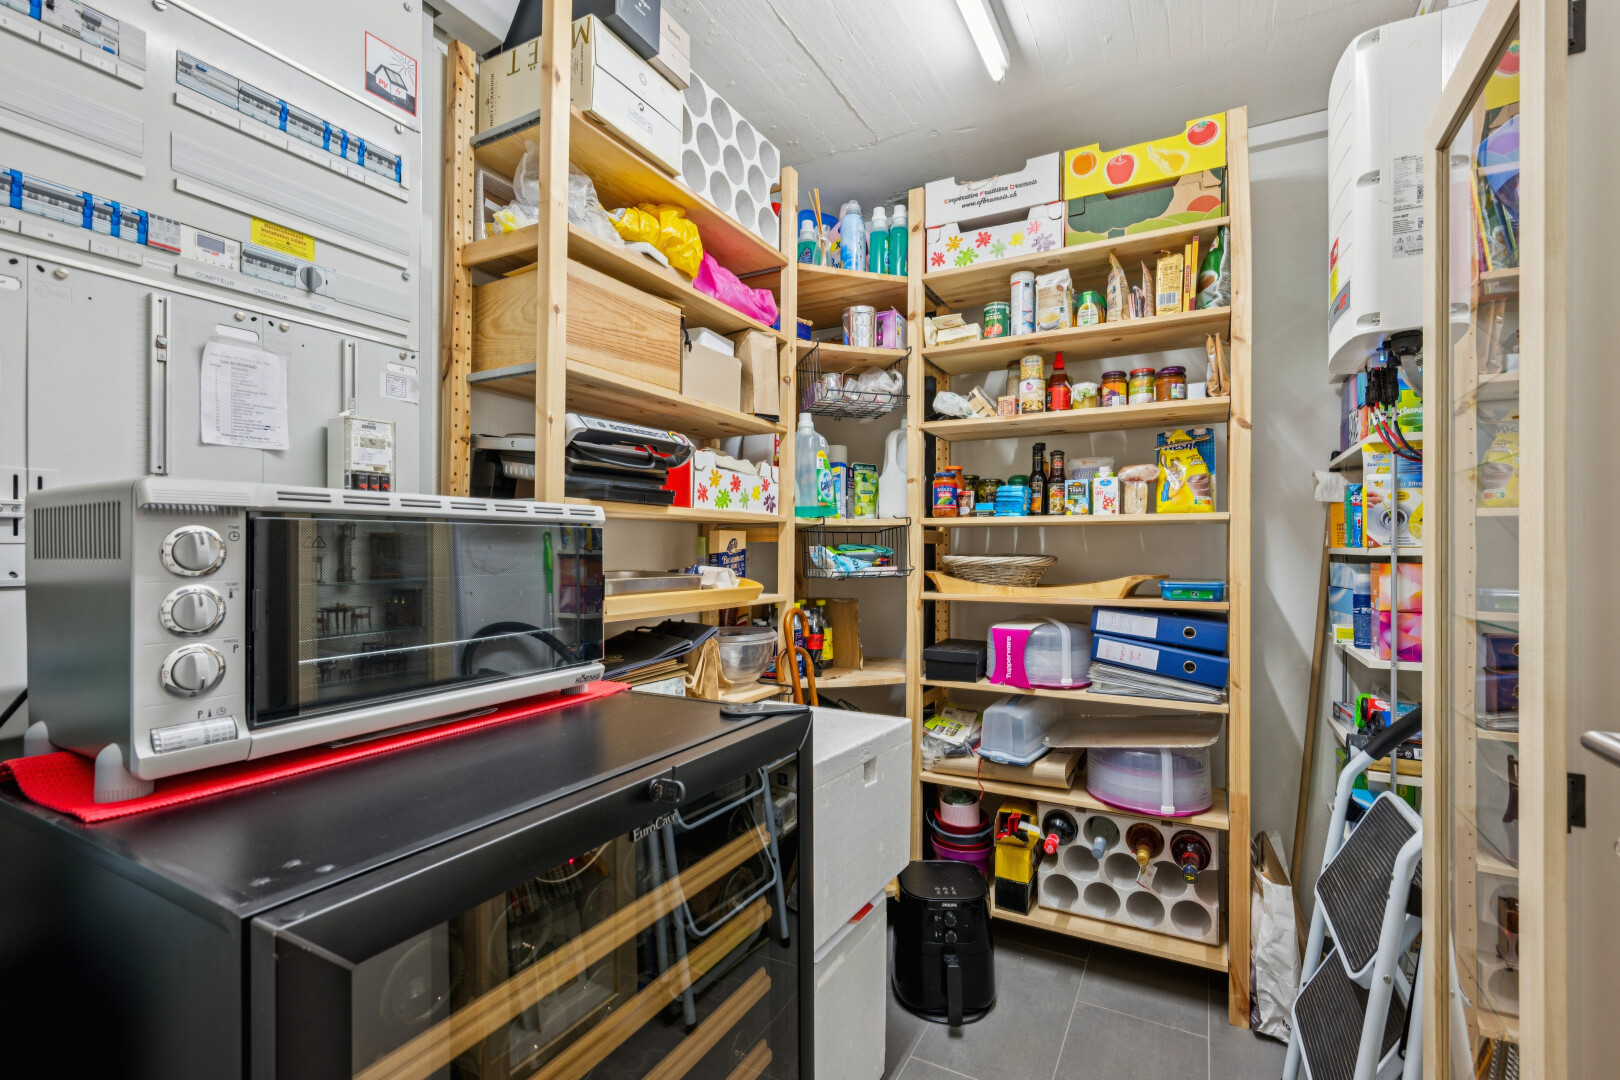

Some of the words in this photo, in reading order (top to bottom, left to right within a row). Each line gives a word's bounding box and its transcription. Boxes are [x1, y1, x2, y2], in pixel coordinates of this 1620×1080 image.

[378, 78, 388, 89] PV
[195, 271, 235, 287] COMPTEUR
[253, 287, 288, 301] ONDULEUR
[1069, 486, 1085, 494] THAI
[233, 644, 239, 653] P
[197, 710, 204, 719] P
[632, 812, 678, 842] EuroCave
